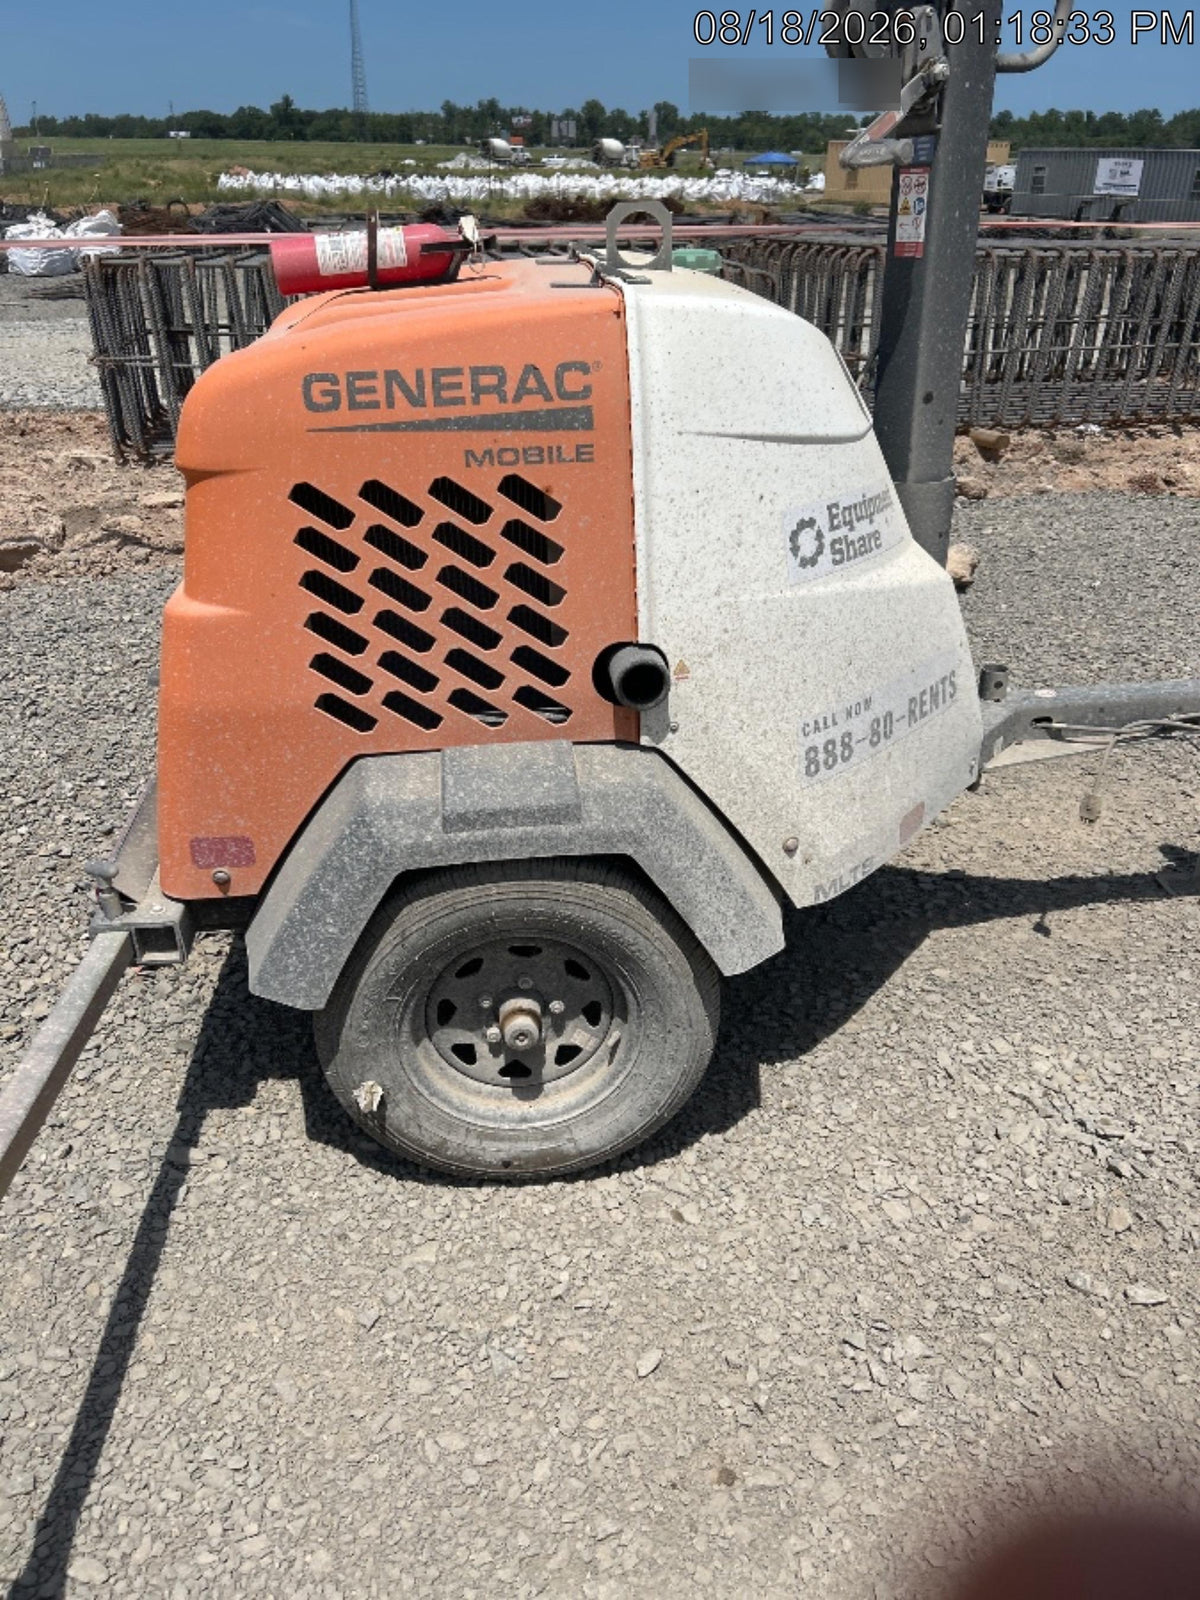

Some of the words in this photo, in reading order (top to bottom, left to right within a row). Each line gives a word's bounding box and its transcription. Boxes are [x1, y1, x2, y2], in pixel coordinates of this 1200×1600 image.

[302, 360, 593, 413] GENERAC
[464, 443, 595, 469] MOBILE
[826, 487, 894, 532] Equip
[829, 529, 882, 566] Share
[802, 711, 838, 737] CALL
[845, 695, 872, 720] NOW
[804, 669, 957, 778] 888-80-RENTS
